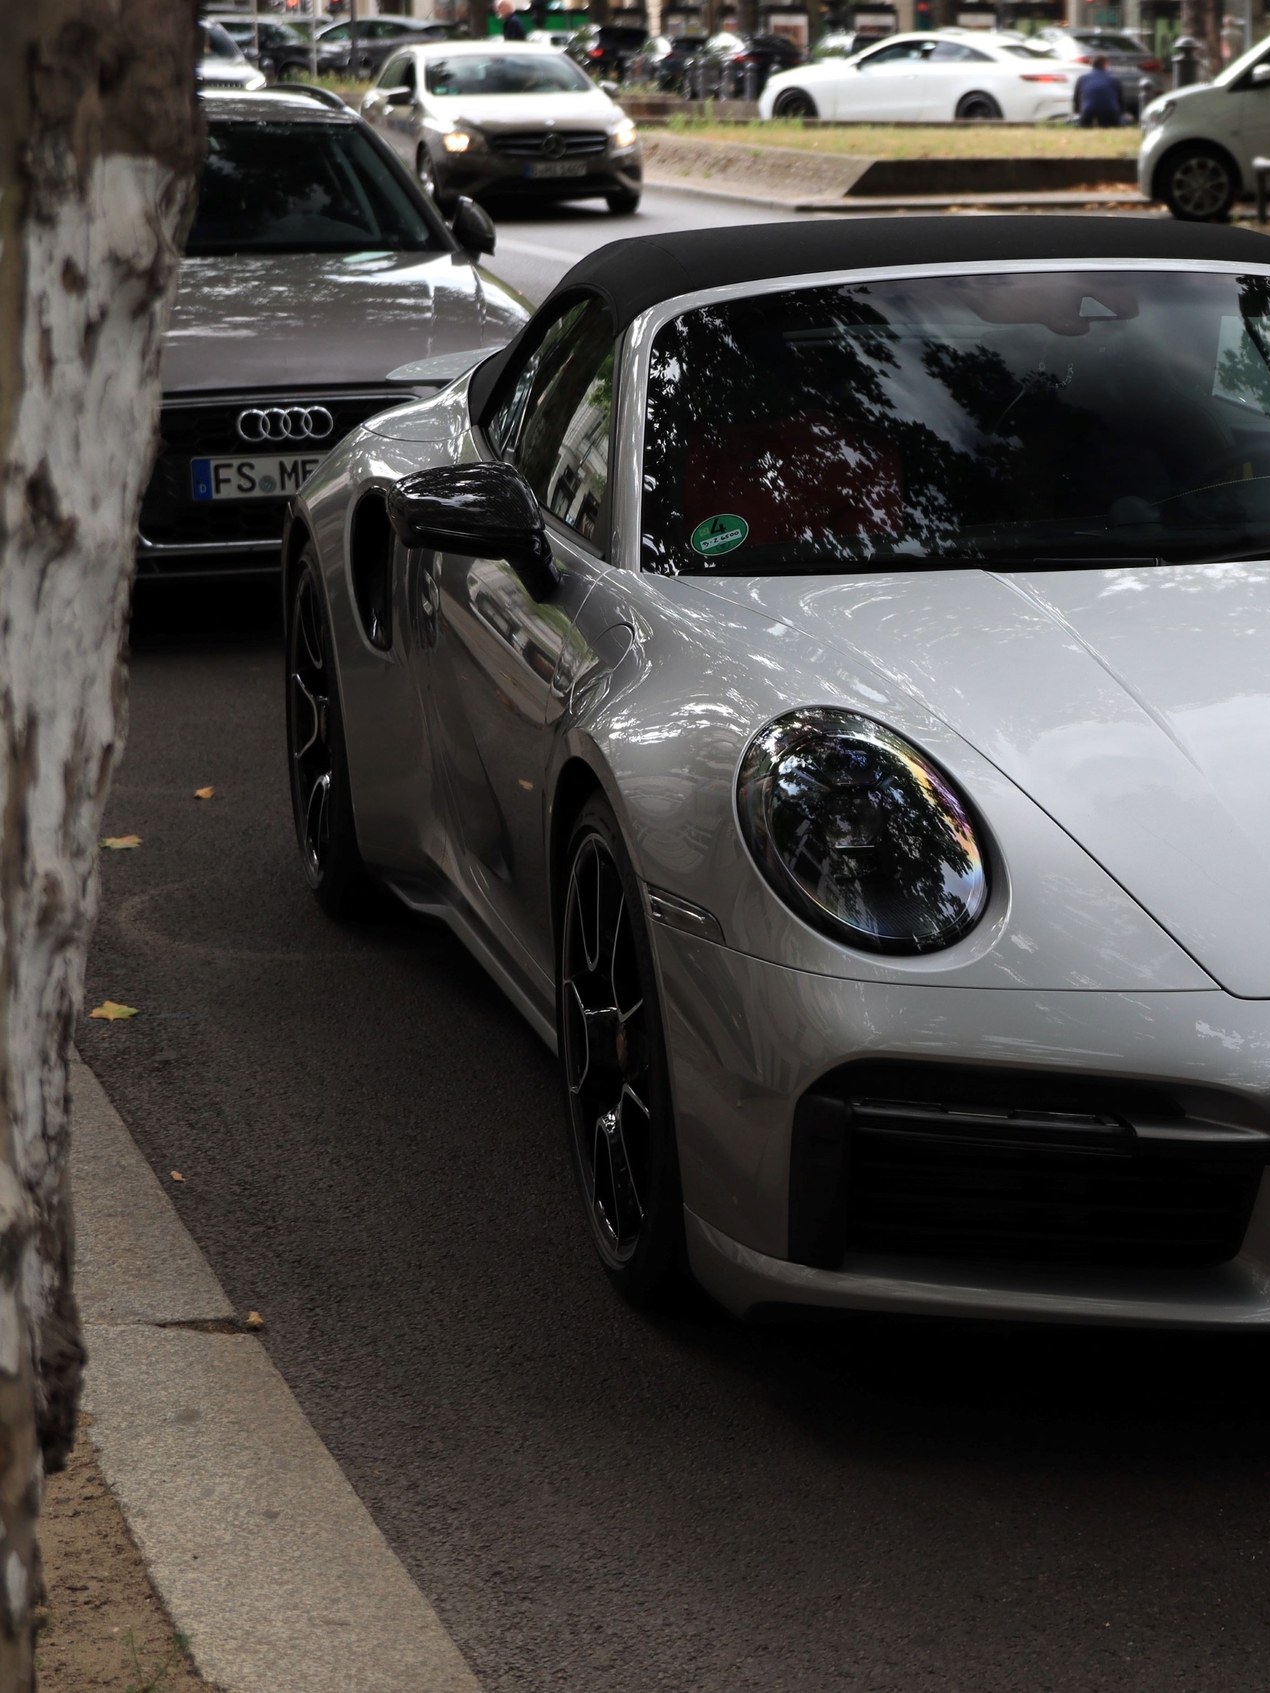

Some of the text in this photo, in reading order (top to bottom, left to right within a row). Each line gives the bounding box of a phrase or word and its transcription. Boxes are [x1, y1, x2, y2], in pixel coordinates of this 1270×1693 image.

[214, 462, 256, 494] FS
[200, 484, 207, 494] D
[711, 517, 727, 534] 4
